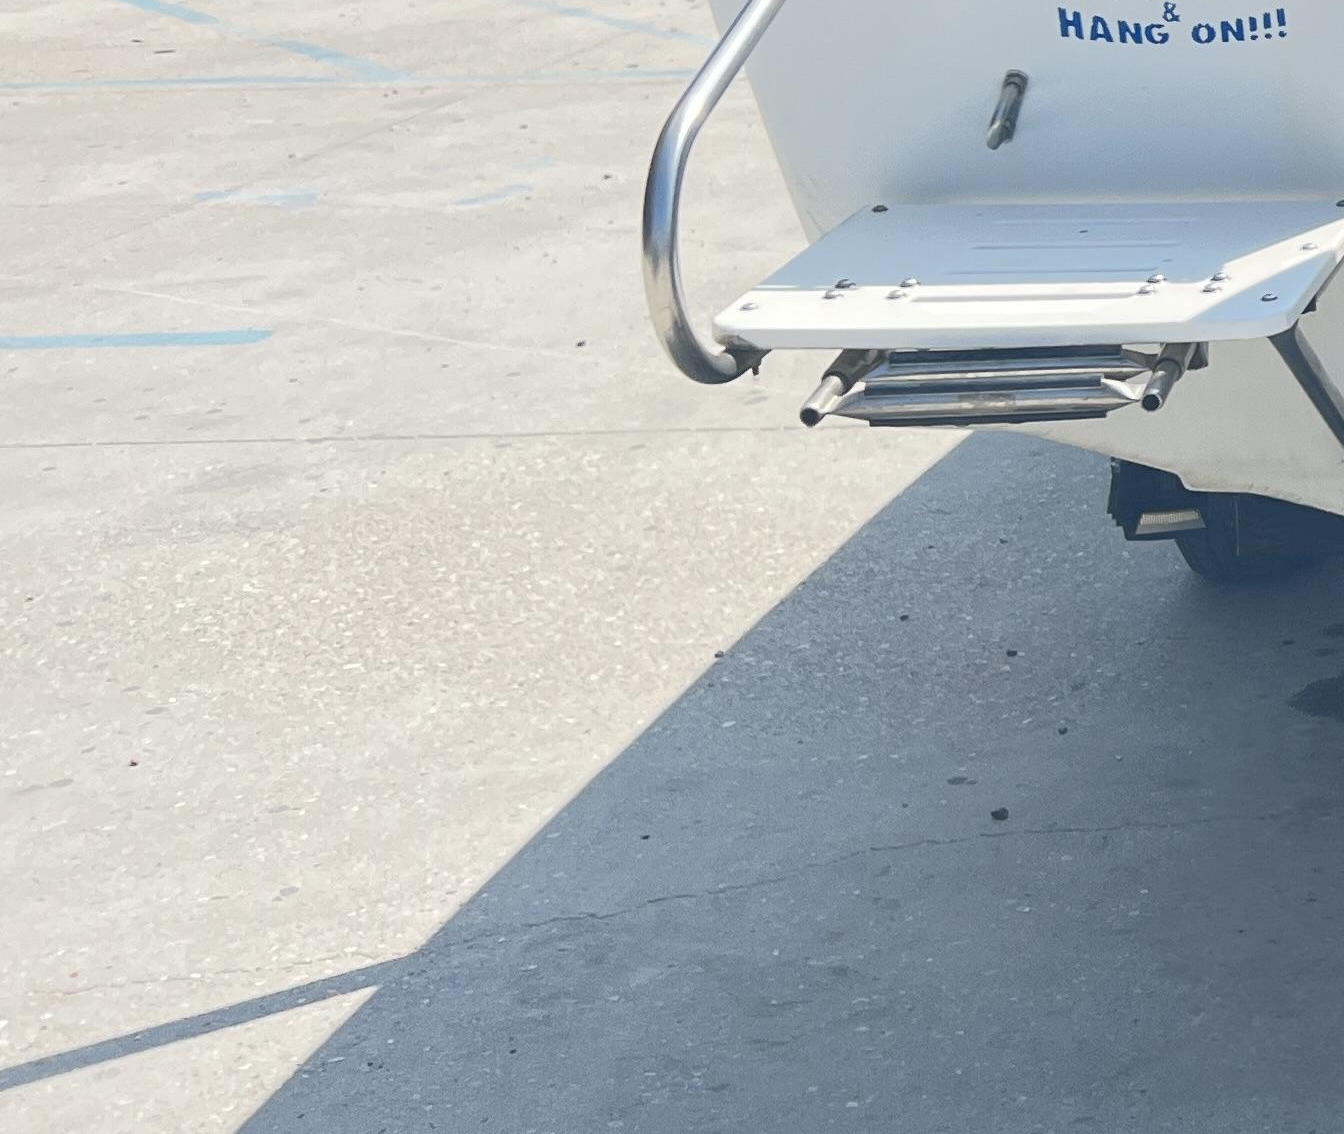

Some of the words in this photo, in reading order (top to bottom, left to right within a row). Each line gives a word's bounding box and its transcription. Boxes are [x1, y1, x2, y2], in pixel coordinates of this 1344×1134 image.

[1058, 7, 1169, 44] HANG
[1191, 8, 1287, 44] ON!!!
[1162, 1, 1181, 22] &
